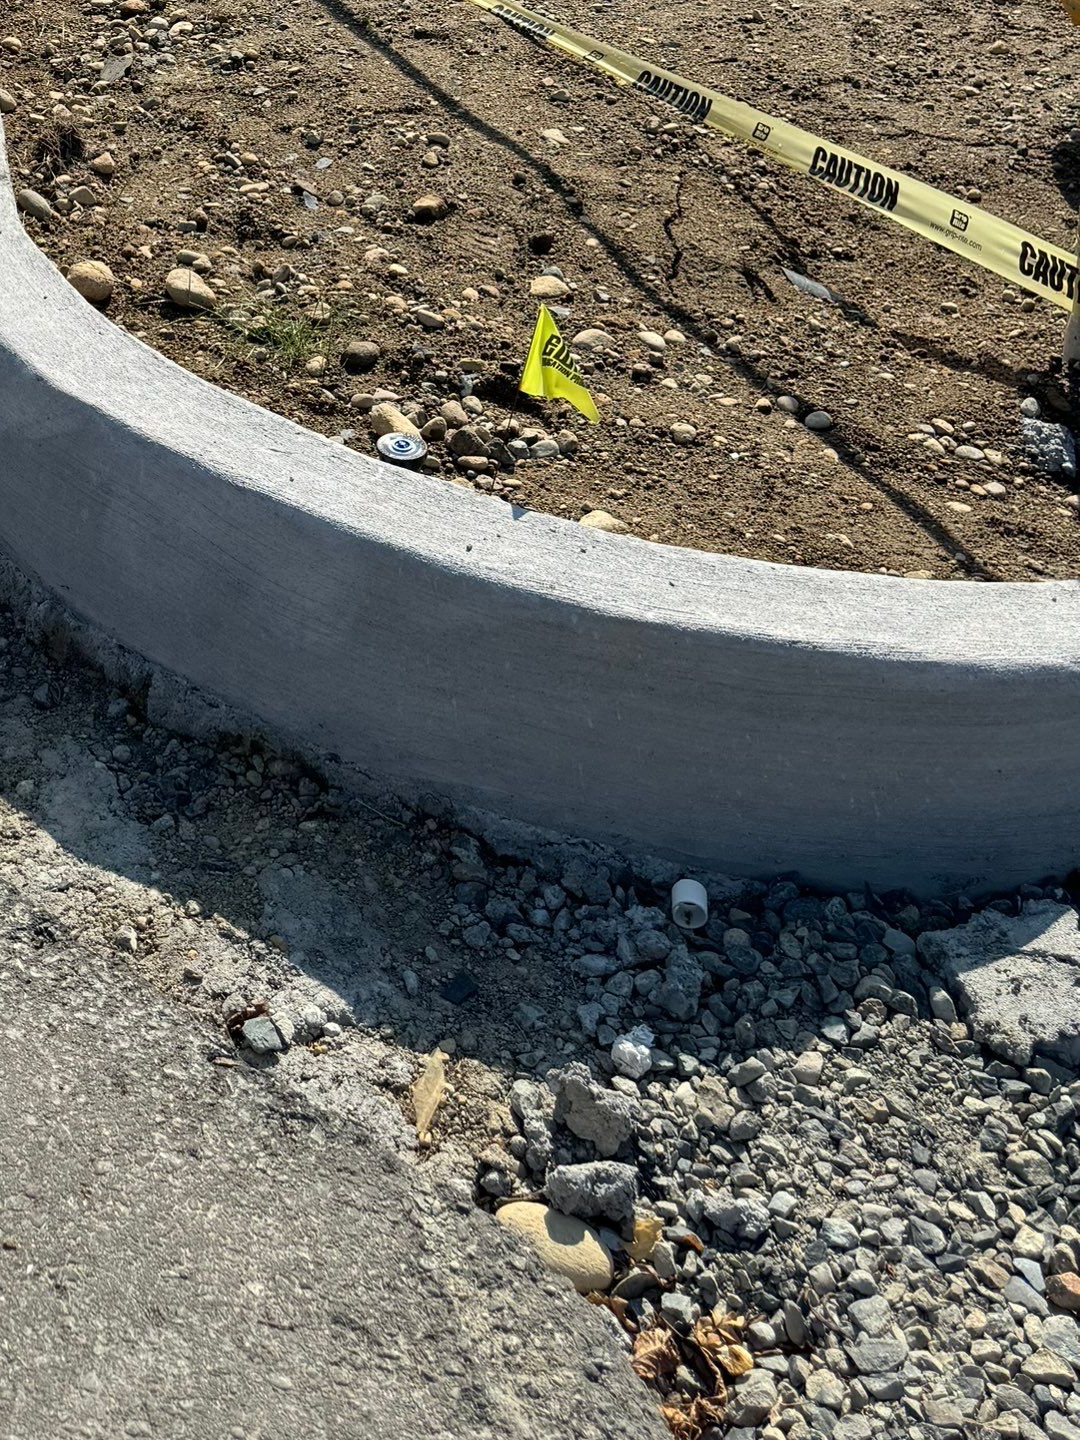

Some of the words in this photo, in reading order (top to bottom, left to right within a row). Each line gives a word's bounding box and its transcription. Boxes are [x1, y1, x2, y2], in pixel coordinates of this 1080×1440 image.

[632, 70, 713, 123] CAUTION
[808, 146, 900, 211] CAUTION
[1019, 240, 1080, 304] CAUT
